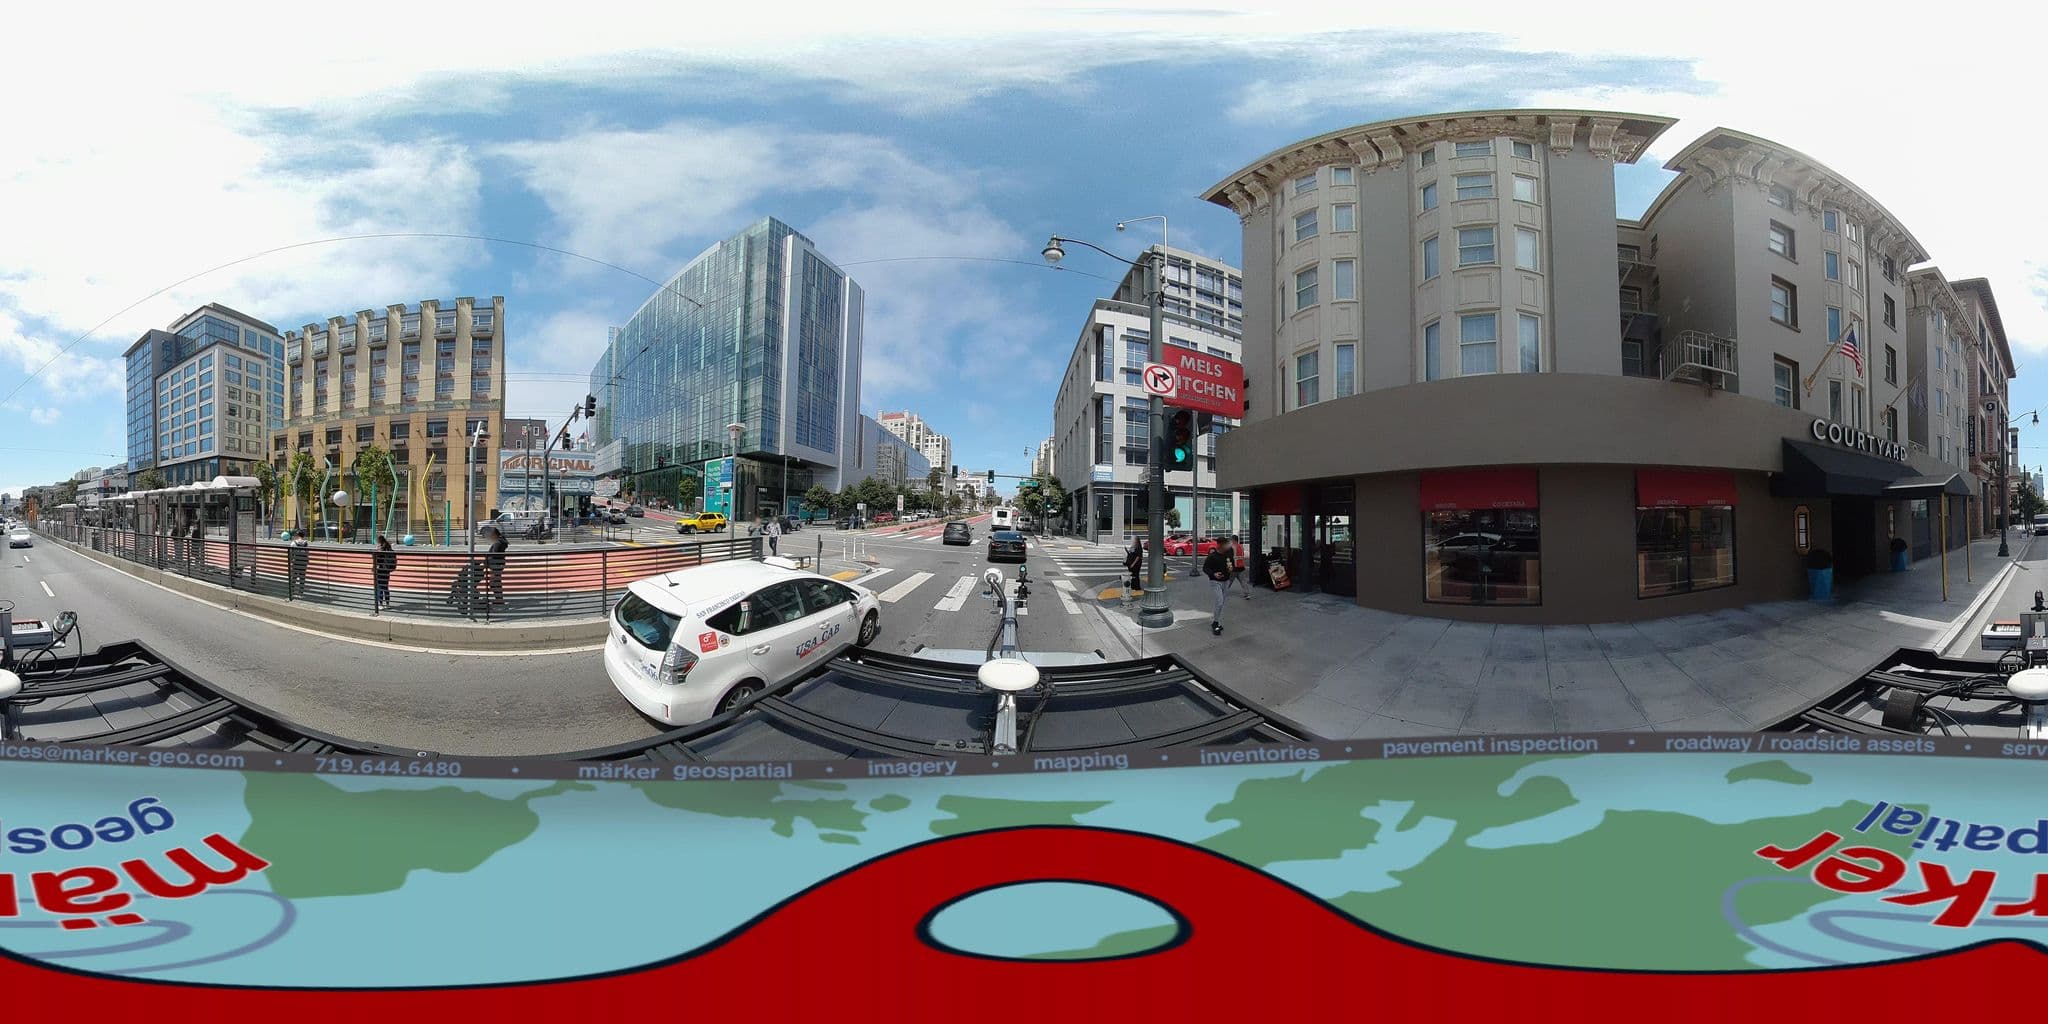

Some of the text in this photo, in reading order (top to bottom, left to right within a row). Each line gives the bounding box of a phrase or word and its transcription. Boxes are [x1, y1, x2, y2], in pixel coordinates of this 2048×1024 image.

[1181, 355, 1222, 377] MELS
[1177, 375, 1236, 402] ITCHEN
[1812, 418, 1908, 461] COURTYARD
[520, 457, 595, 470] ORGINAL
[796, 636, 817, 656] USA
[821, 623, 840, 642] CAB
